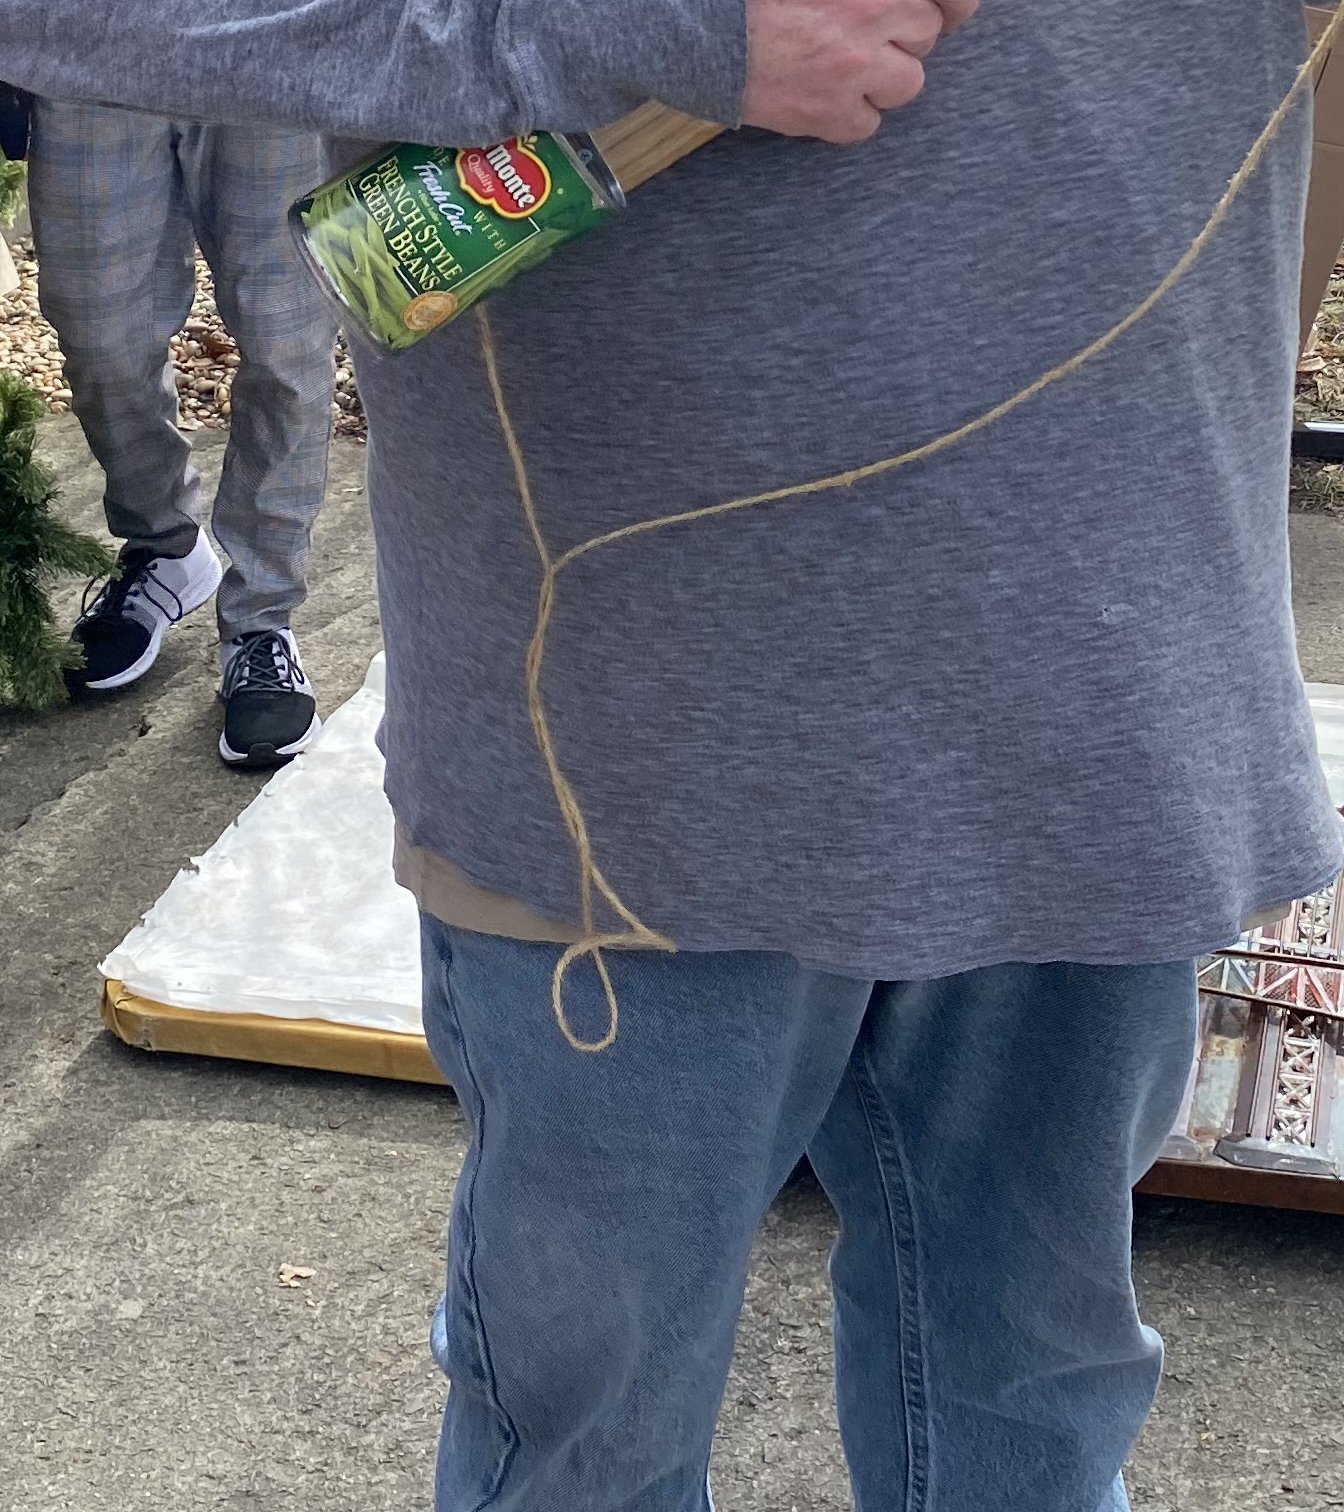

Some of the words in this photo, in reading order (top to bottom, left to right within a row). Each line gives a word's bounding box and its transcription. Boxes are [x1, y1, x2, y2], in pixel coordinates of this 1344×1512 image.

[413, 160, 451, 204] Fresh
[438, 202, 474, 235] Cut
[467, 153, 495, 194] Quality
[485, 144, 536, 208] Monte
[359, 172, 401, 234] GREEN
[389, 228, 441, 291] BEANS
[377, 155, 427, 231] FRENCH
[415, 224, 463, 281] STYLE
[473, 210, 507, 250] WITH
